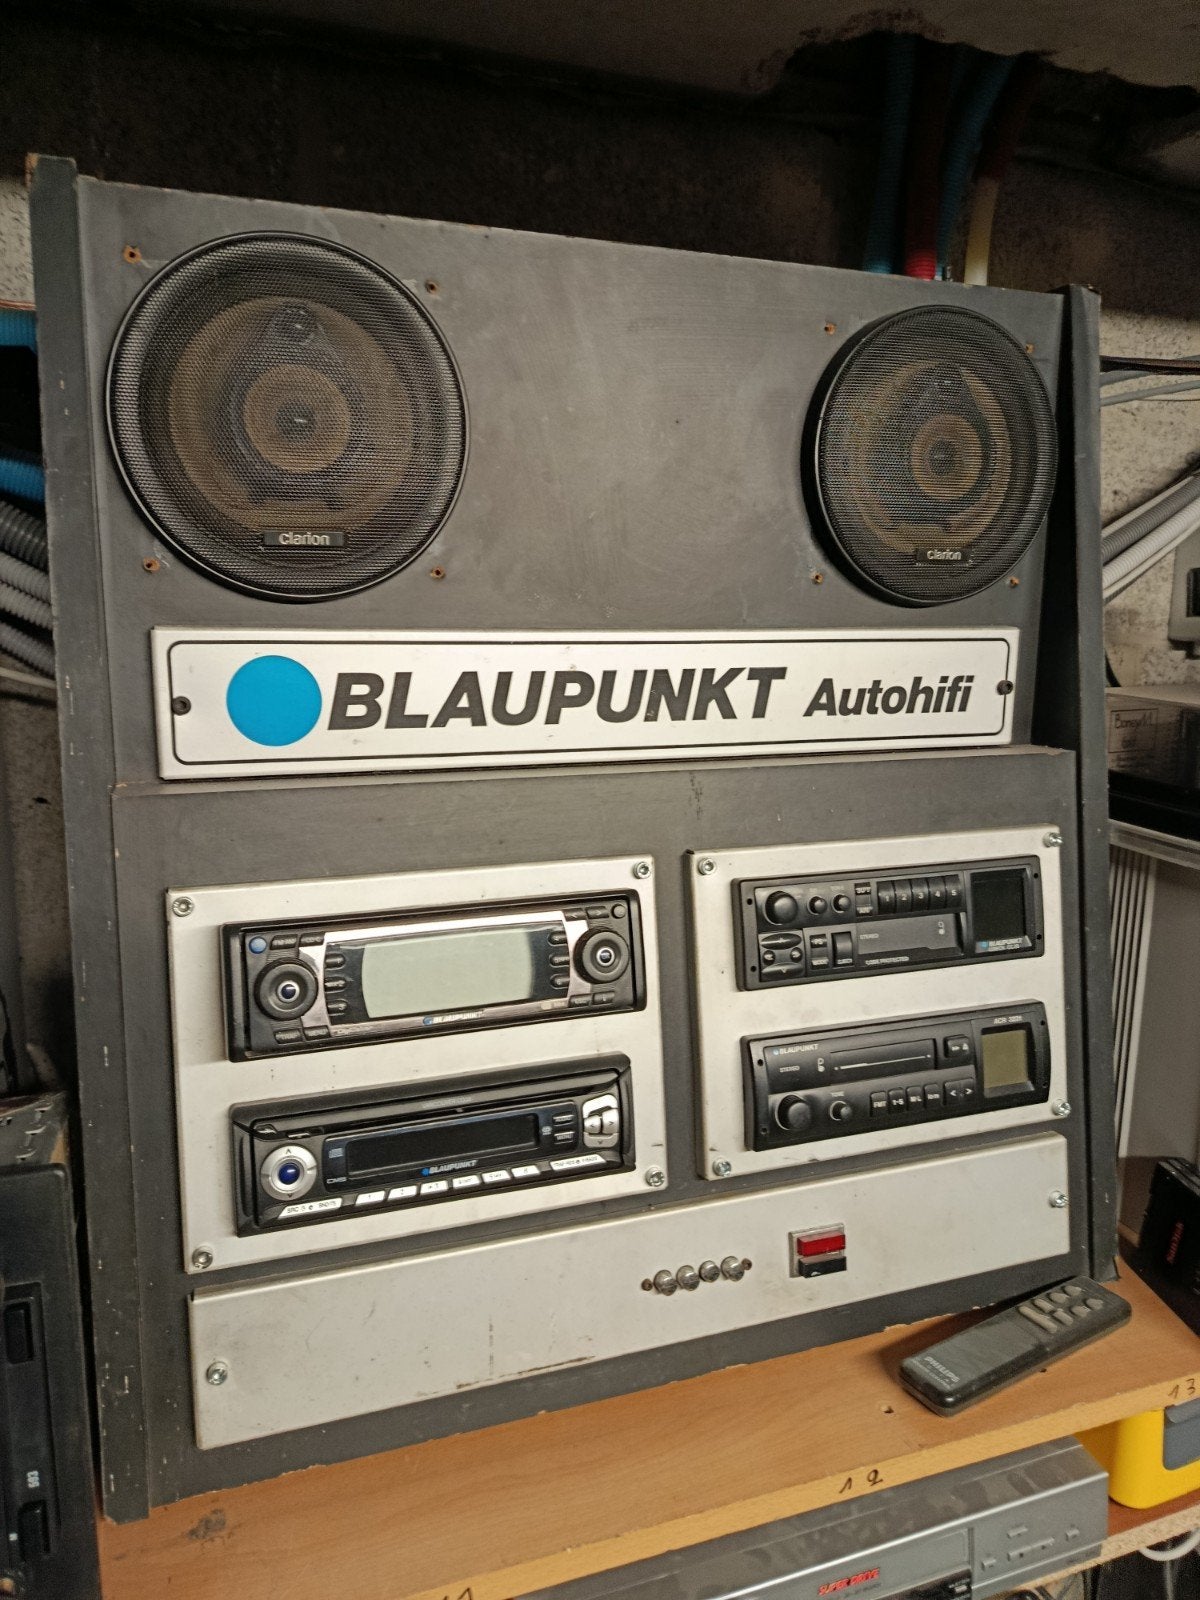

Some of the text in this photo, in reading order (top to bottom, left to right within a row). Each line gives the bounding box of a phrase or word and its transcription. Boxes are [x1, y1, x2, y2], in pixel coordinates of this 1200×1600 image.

[327, 666, 975, 731] BLAUPUNKT Autohifi
[918, 892, 925, 900] 3
[934, 890, 941, 898] 4
[779, 1043, 819, 1055] BLAUPUNKT
[429, 1159, 479, 1174] BLAUPUNKT
[923, 1356, 961, 1384] PHILIPS
